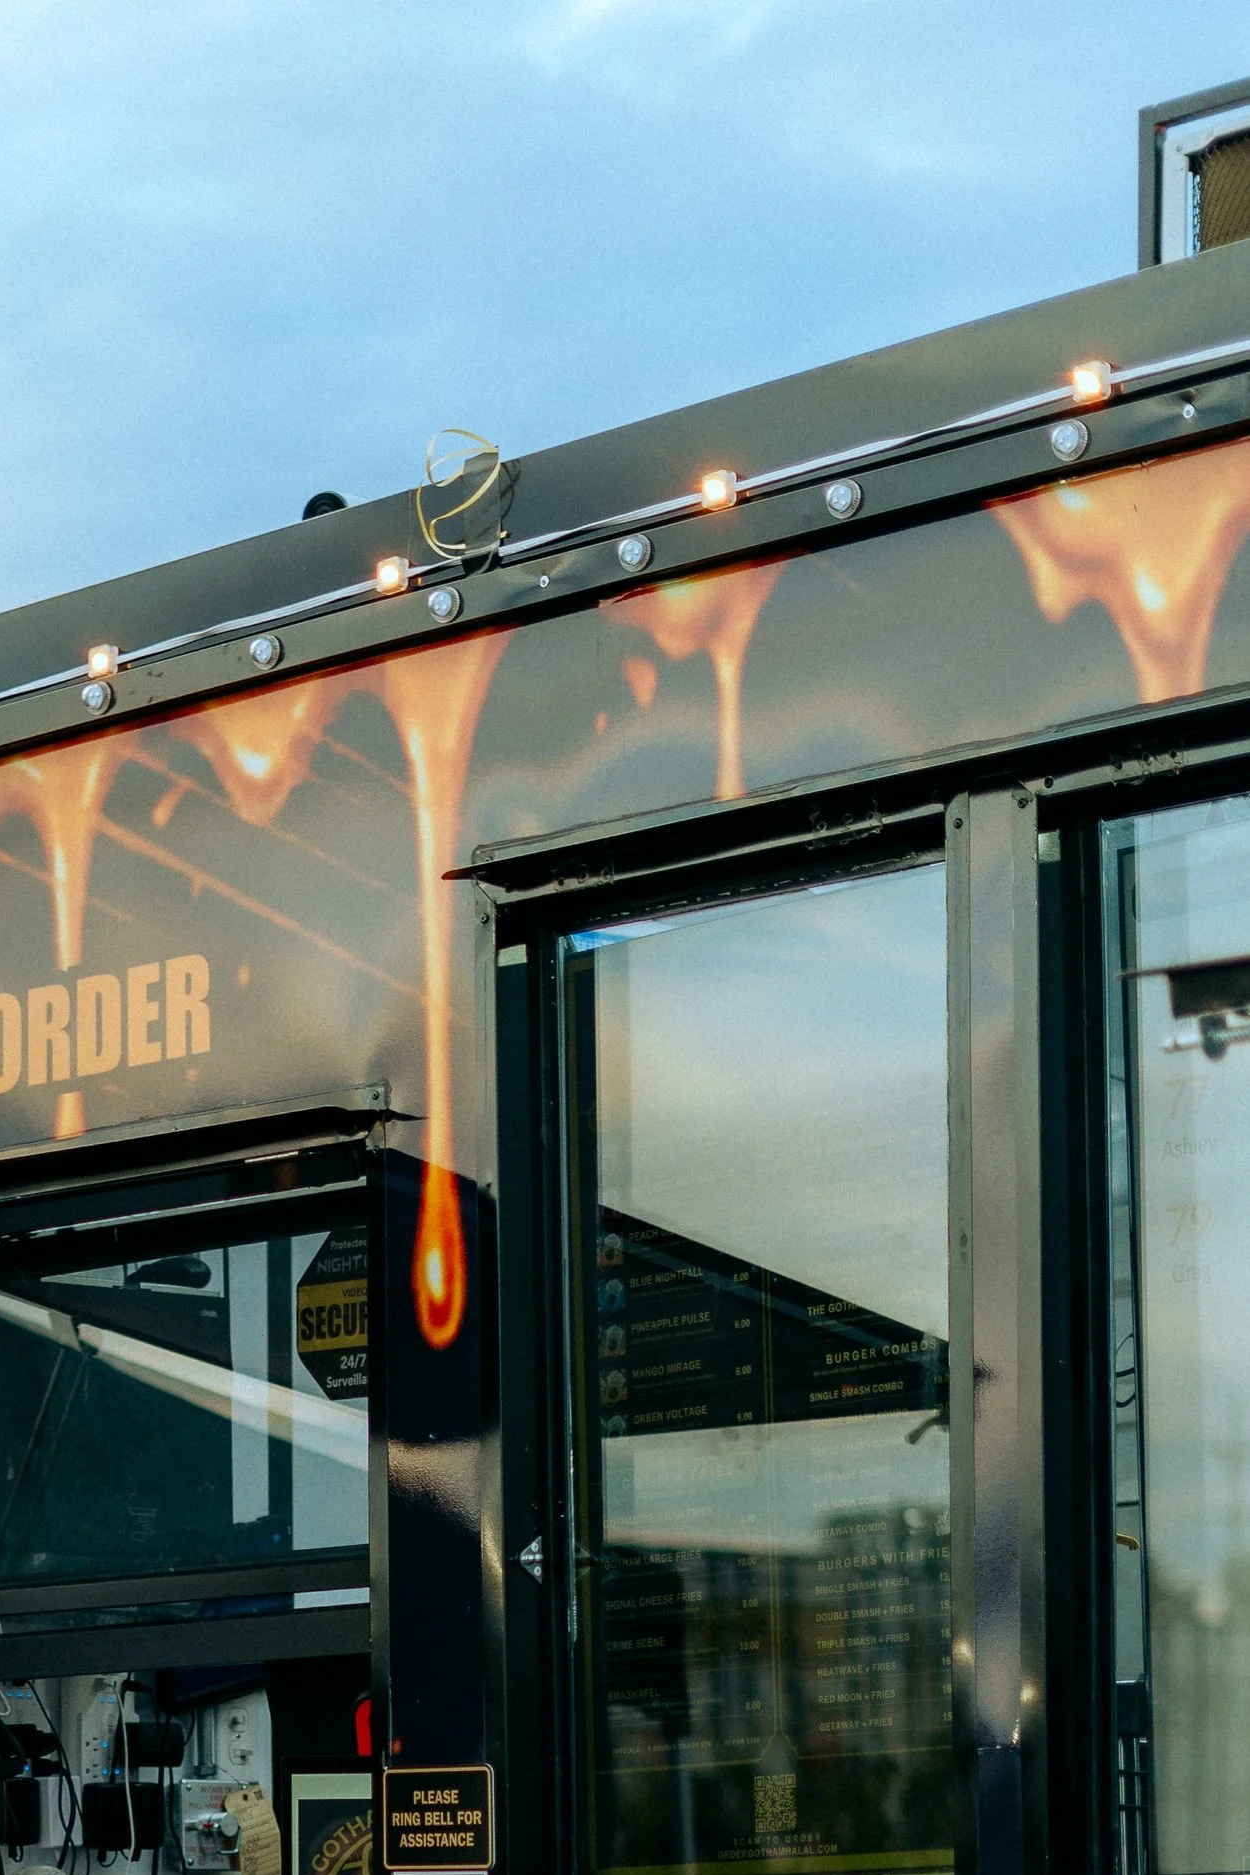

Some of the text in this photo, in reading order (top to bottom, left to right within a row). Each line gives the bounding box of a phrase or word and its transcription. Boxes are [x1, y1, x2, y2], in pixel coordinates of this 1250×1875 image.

[1163, 1137, 1217, 1160] Ashley
[630, 1274, 652, 1288] BLUE
[655, 1267, 704, 1284] NIGHTFALL
[807, 1304, 825, 1316] THE
[631, 1317, 678, 1333] PINEAPPLE
[681, 1312, 710, 1325] PULSE
[826, 1339, 936, 1364] BURGER COMBOS
[340, 1353, 367, 1369] 24/7
[632, 1365, 664, 1378] MANGO
[666, 1360, 701, 1374] MIRAGE
[809, 1381, 903, 1402] SINGLE SMASH COMBO
[633, 1412, 663, 1424] GREEN
[666, 1405, 707, 1419] VOLTAGE
[856, 1522, 886, 1534] COMBO
[605, 1557, 641, 1570] GOTHAM
[644, 1553, 672, 1565] LARGE
[676, 1550, 701, 1562] FRIES
[818, 1555, 877, 1571] BURGERS
[883, 1550, 913, 1564] WITH
[815, 1577, 910, 1595] SINGLE SMASH FRIES
[605, 1600, 636, 1611] SIGNAL
[639, 1594, 673, 1607] CHEESE
[676, 1591, 702, 1602] FRIES
[816, 1604, 914, 1622] DOUBLE SMASH FRIES
[606, 1640, 632, 1651] CRIME
[636, 1636, 664, 1648] SCENE
[816, 1632, 910, 1649] TRIPLE SMASH FRIES
[817, 1665, 862, 1677] HEATWAVE
[872, 1660, 896, 1671] FRIES
[819, 1695, 835, 1704] RED
[838, 1692, 862, 1703] MOON
[872, 1689, 895, 1700] FRIES
[819, 1720, 859, 1732] GETAWAY
[869, 1716, 893, 1727] FRIES
[413, 1790, 459, 1805] PLEASE
[392, 1811, 482, 1826] RING BELL FOR
[399, 1832, 474, 1848] ASSISTANCE
[734, 1837, 760, 1846] SCAN
[785, 1833, 822, 1842] ORDER
